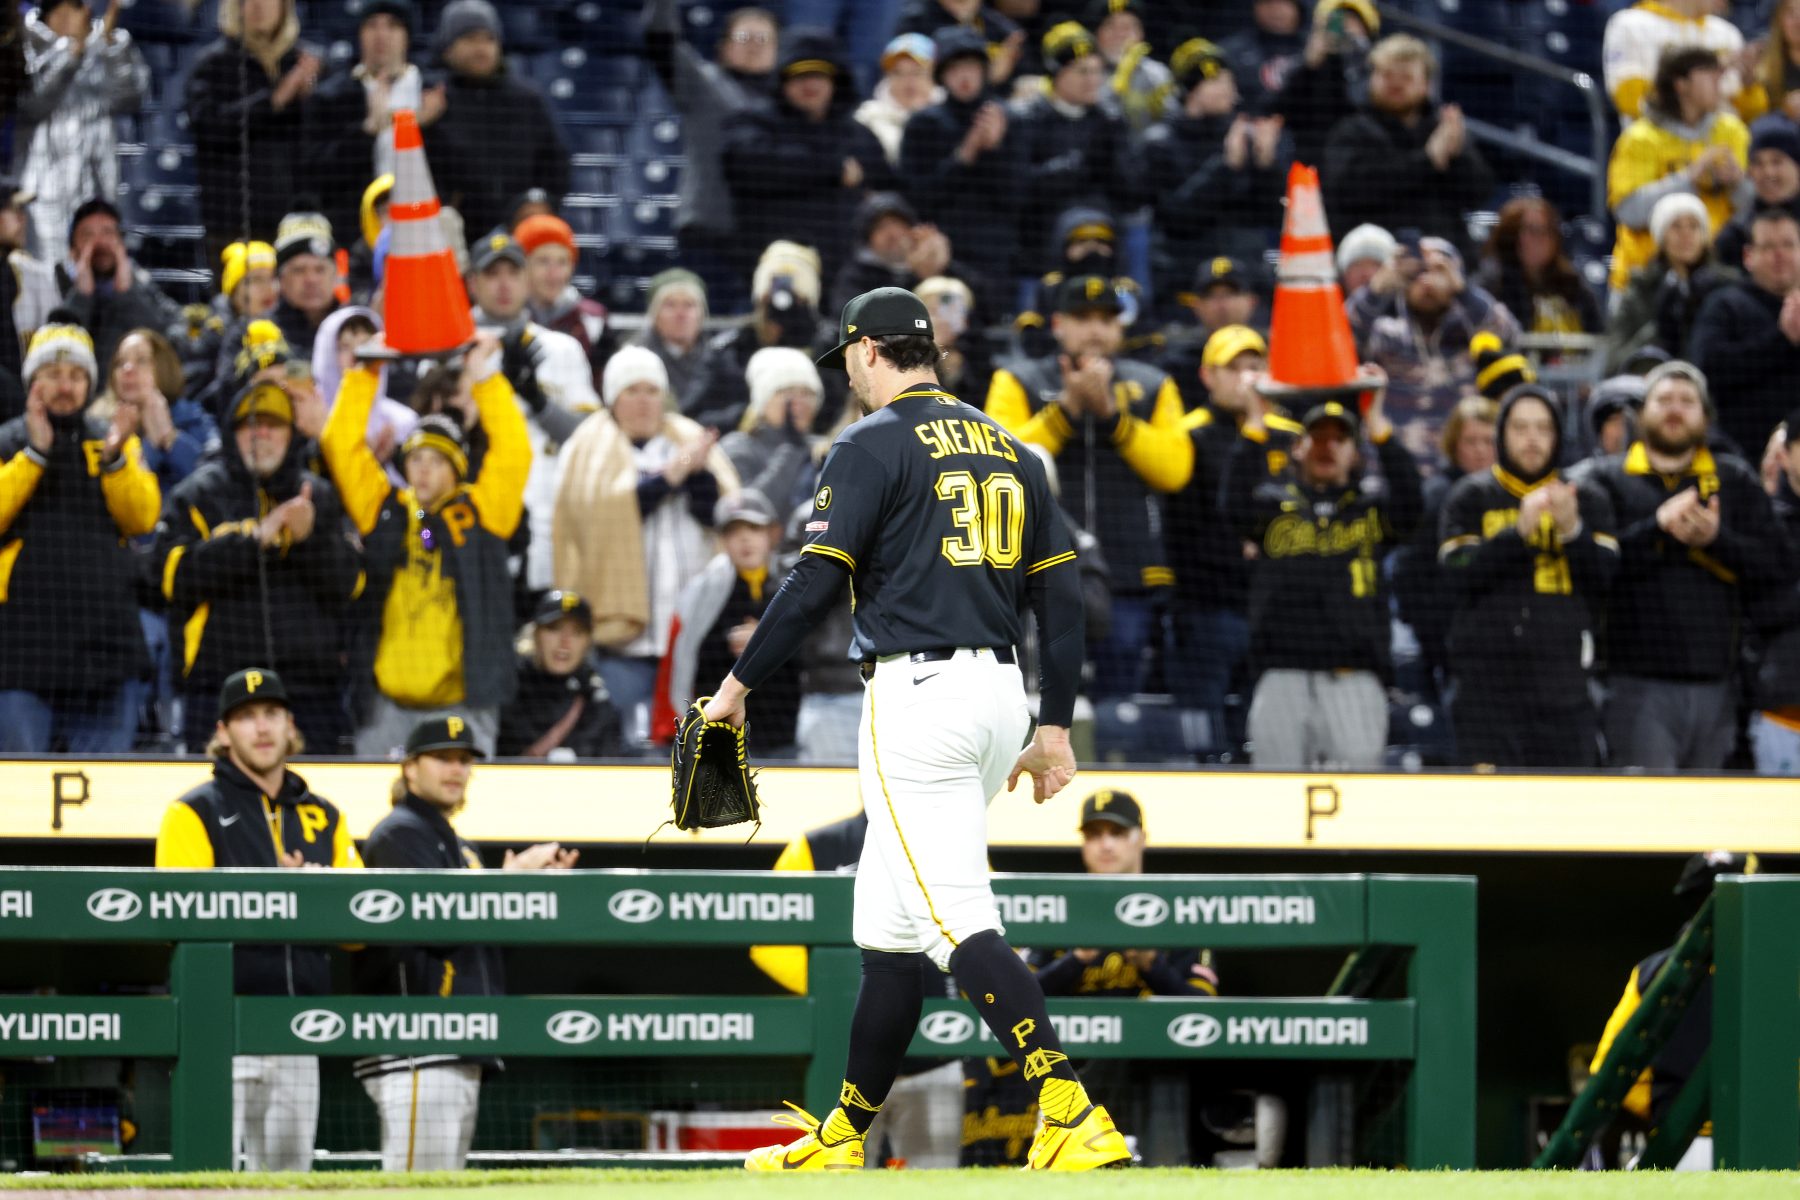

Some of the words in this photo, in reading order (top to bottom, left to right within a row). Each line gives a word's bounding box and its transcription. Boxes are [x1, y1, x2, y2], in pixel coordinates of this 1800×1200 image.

[915, 419, 1018, 463] SKENES
[441, 503, 475, 547] P
[934, 470, 1025, 569] 30
[245, 670, 263, 694] P
[447, 716, 464, 740] P
[53, 771, 90, 831] P
[1094, 791, 1113, 811] P
[1306, 784, 1339, 841] P
[297, 804, 329, 843] P
[150, 891, 298, 919] HYUNDAI
[411, 892, 558, 920] HYUNDAI
[669, 893, 814, 921] HYUNDAI
[994, 894, 1067, 923] NDAI
[1174, 895, 1315, 924] HYUNDAI
[352, 1012, 498, 1041] HYUNDAI
[607, 1013, 754, 1041] HYUNDAI
[1011, 1017, 1037, 1049] P
[1227, 1017, 1368, 1045] HYUNDAI
